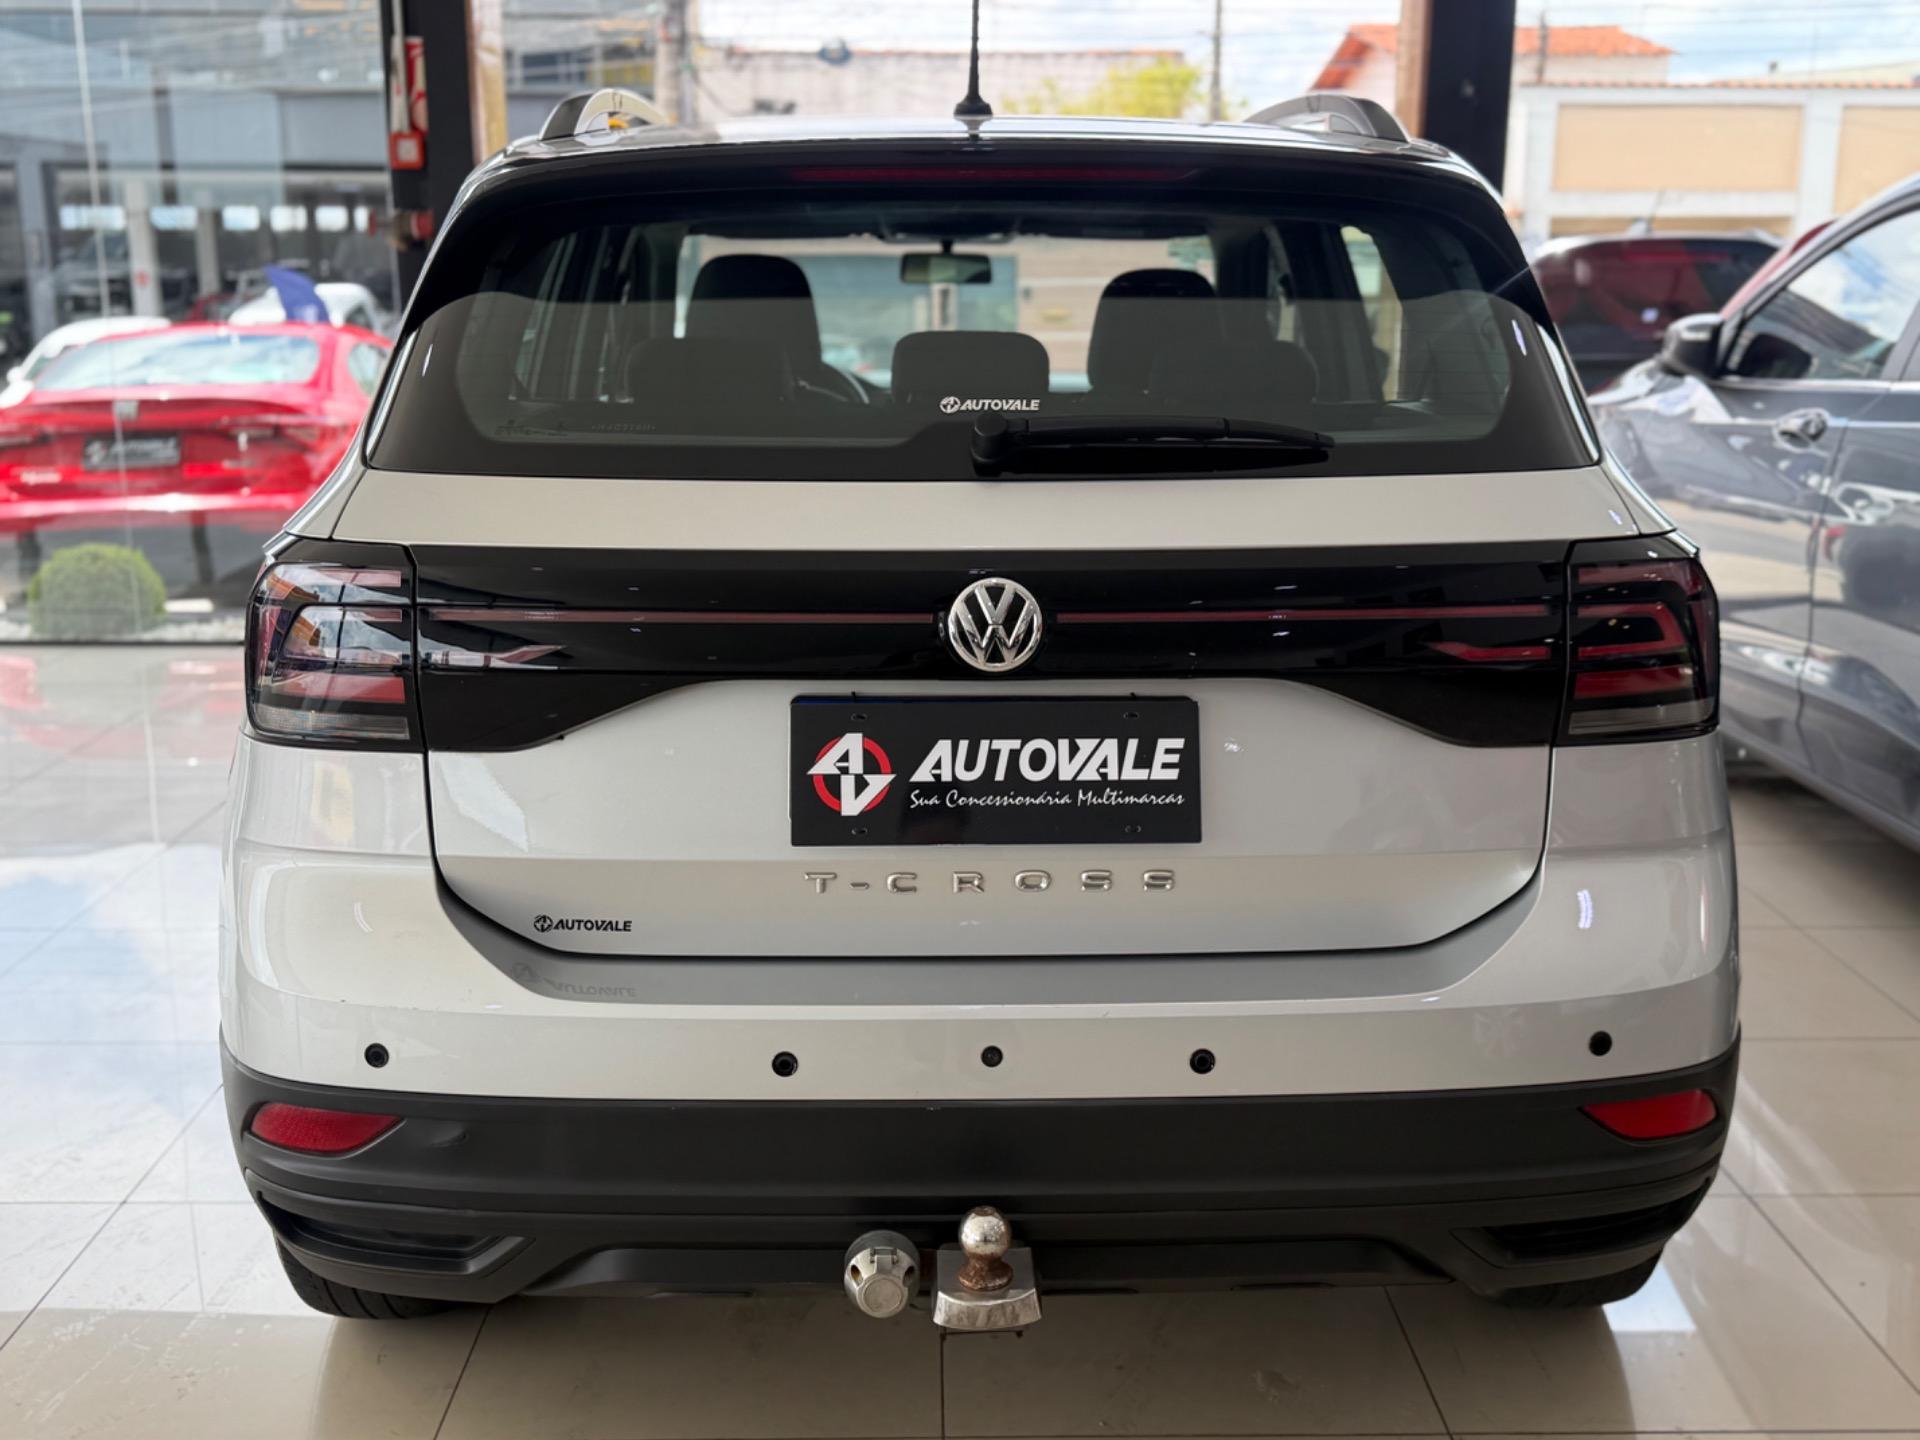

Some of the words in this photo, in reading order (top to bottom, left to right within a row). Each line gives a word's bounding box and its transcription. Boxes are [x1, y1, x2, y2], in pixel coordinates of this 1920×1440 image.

[960, 399, 1040, 411] AUTOVALE
[909, 738, 1185, 782] AUTOVALE
[910, 789, 941, 809] Sua
[1077, 787, 1185, 807] Multimarcas
[804, 869, 1175, 894] T-CROSS
[553, 918, 632, 932] AUTOVALE
